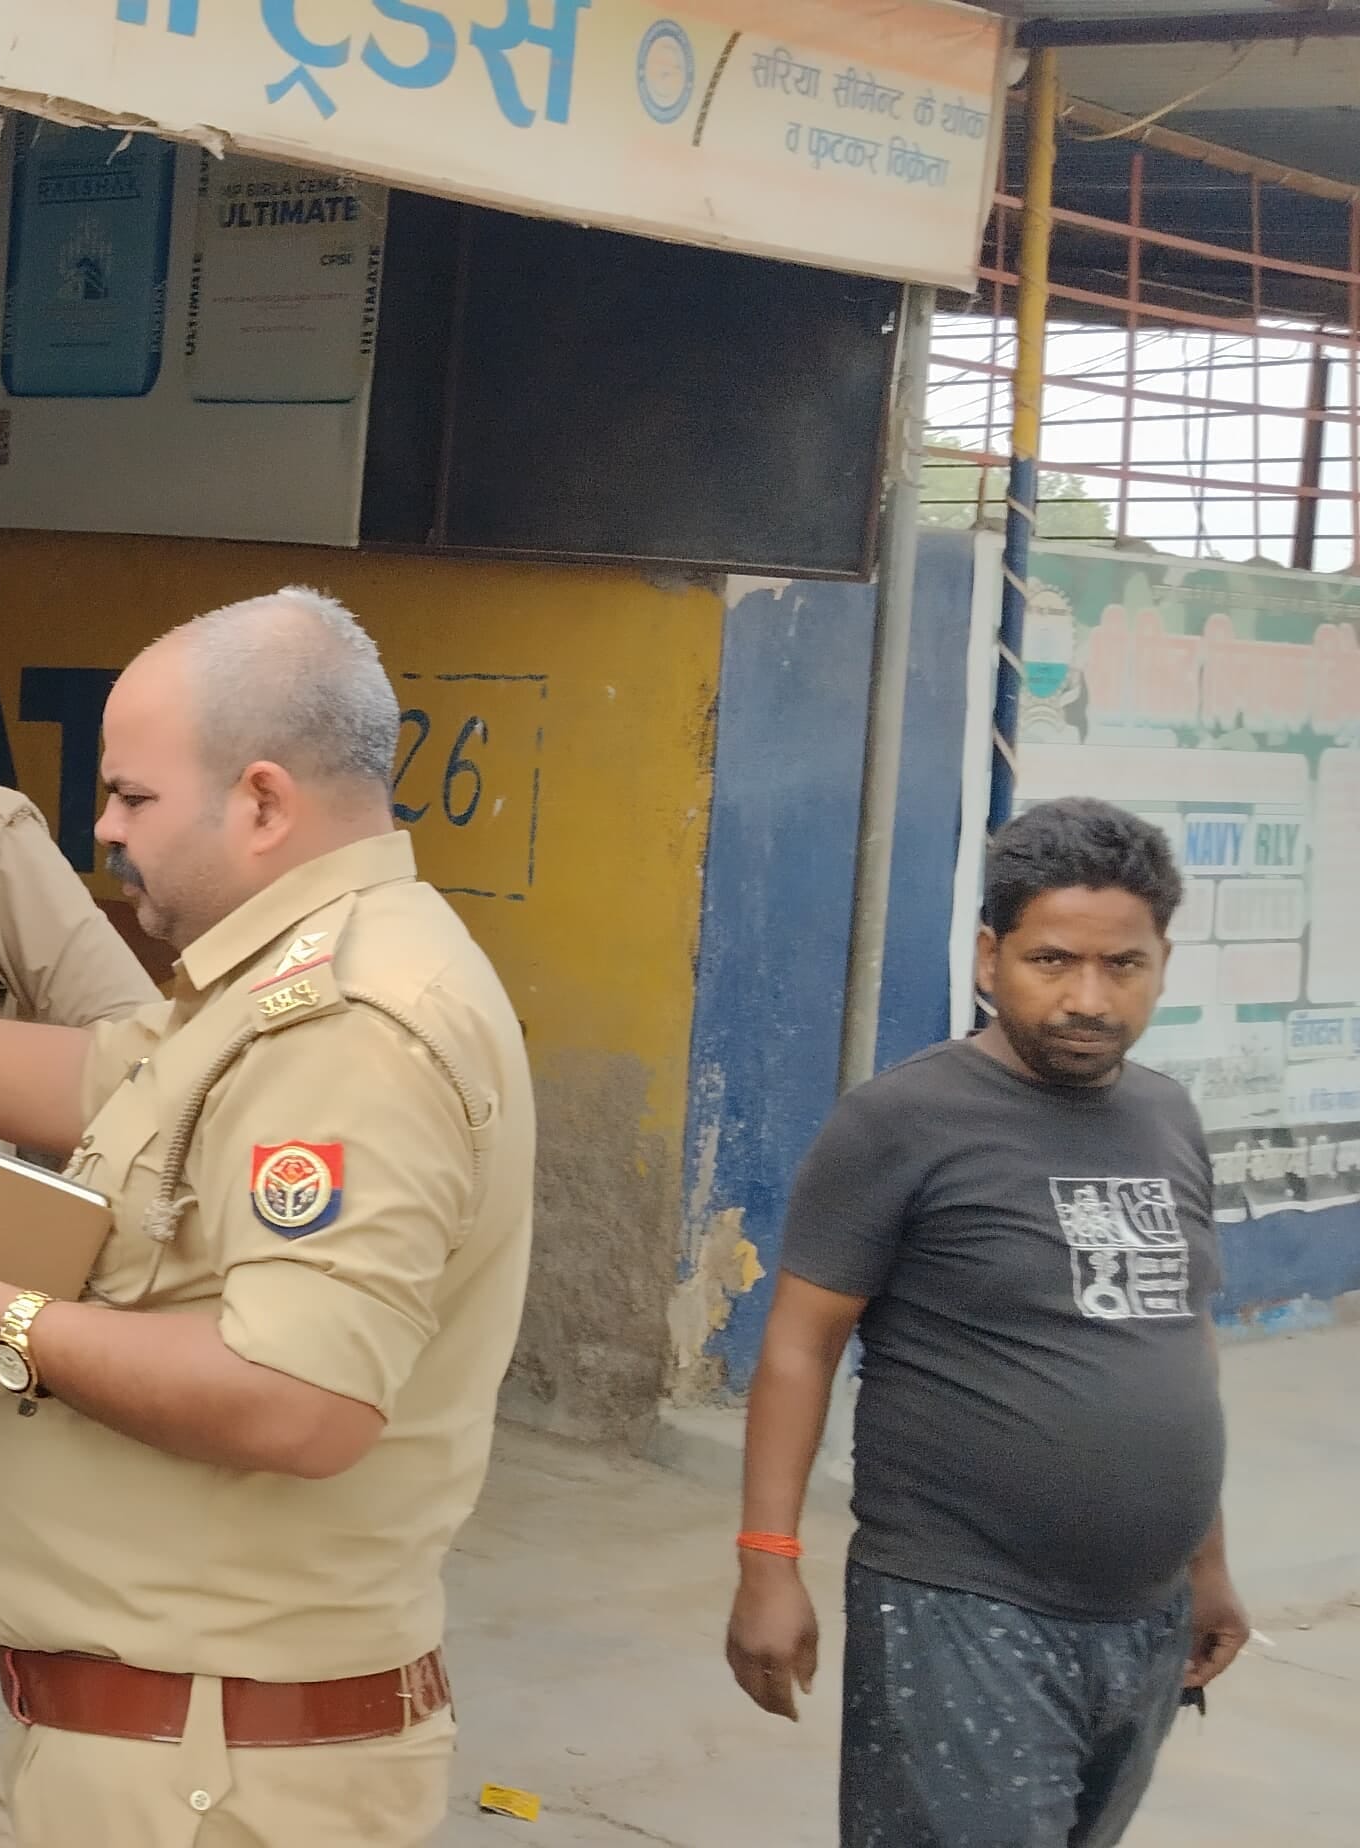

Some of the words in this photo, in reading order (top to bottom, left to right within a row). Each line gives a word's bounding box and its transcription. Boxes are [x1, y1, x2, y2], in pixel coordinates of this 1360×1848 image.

[752, 47, 821, 99] सरिया
[913, 88, 936, 127] के
[221, 196, 360, 228] ULTIMATE
[1184, 821, 1244, 867] NAVY
